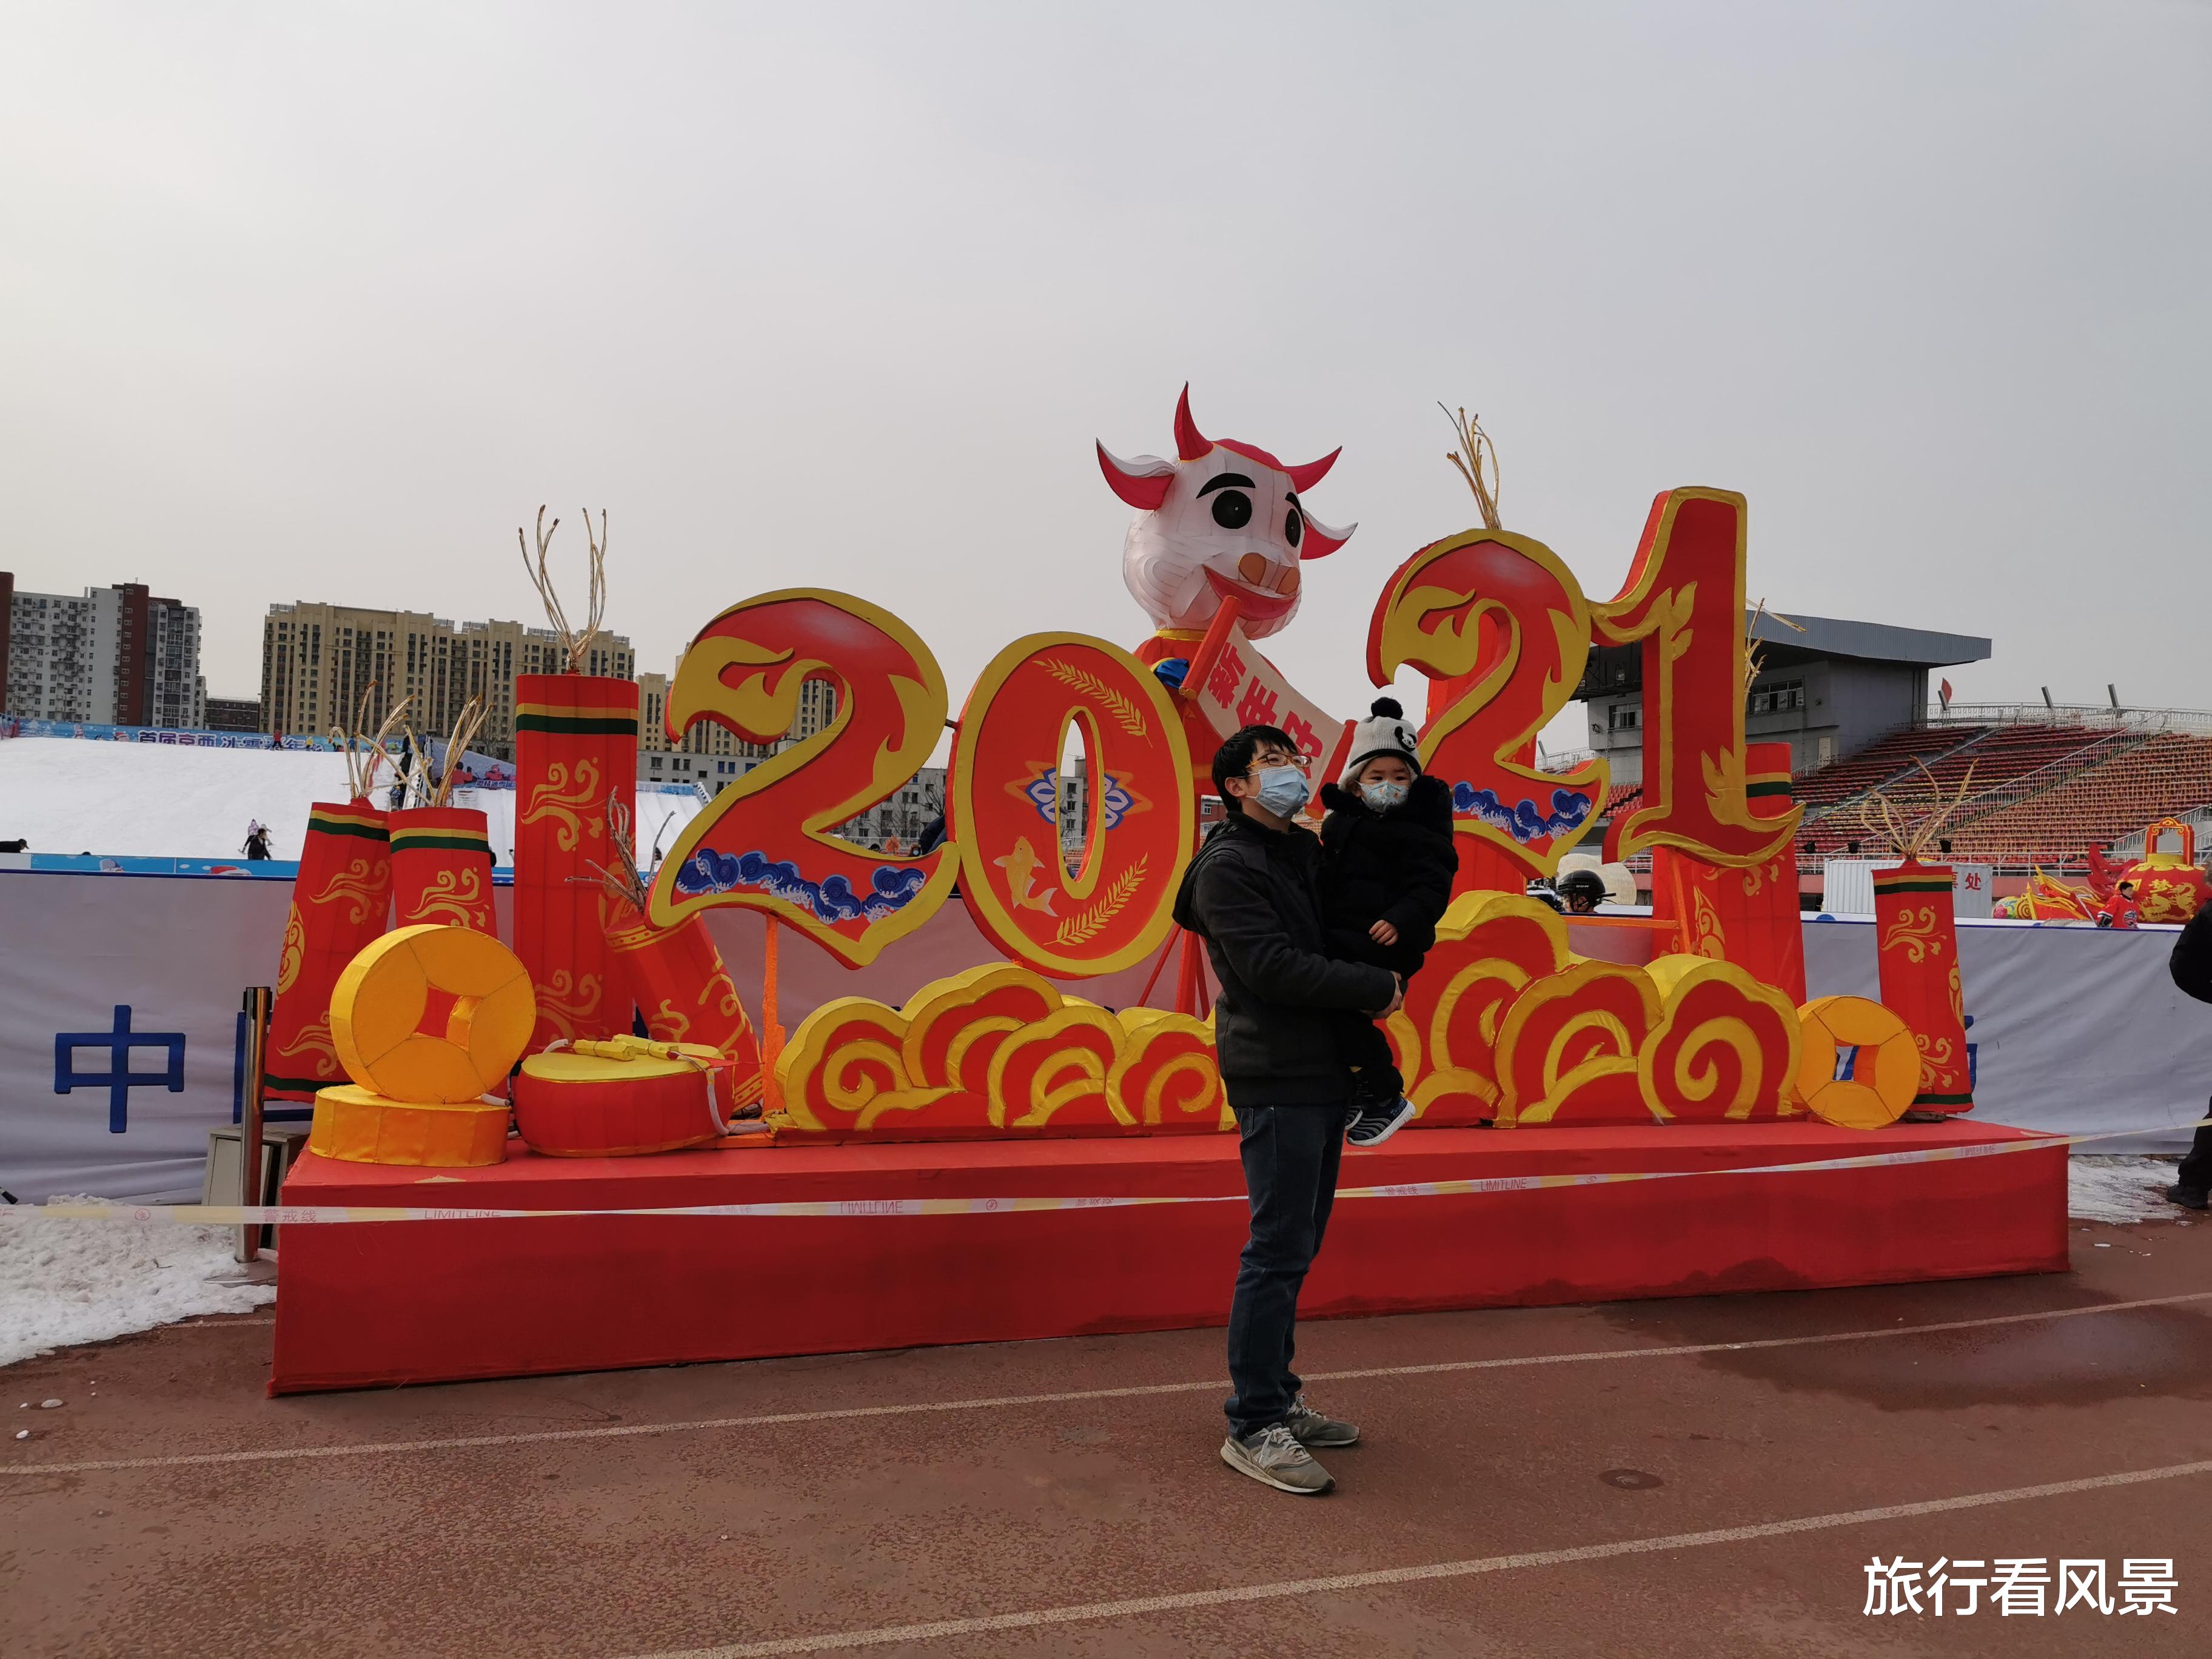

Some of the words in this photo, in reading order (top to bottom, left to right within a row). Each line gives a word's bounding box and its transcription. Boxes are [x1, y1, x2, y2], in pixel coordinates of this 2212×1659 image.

[1480, 1178, 1527, 1191] LIMITLINE
[263, 1208, 317, 1222] 警戒线
